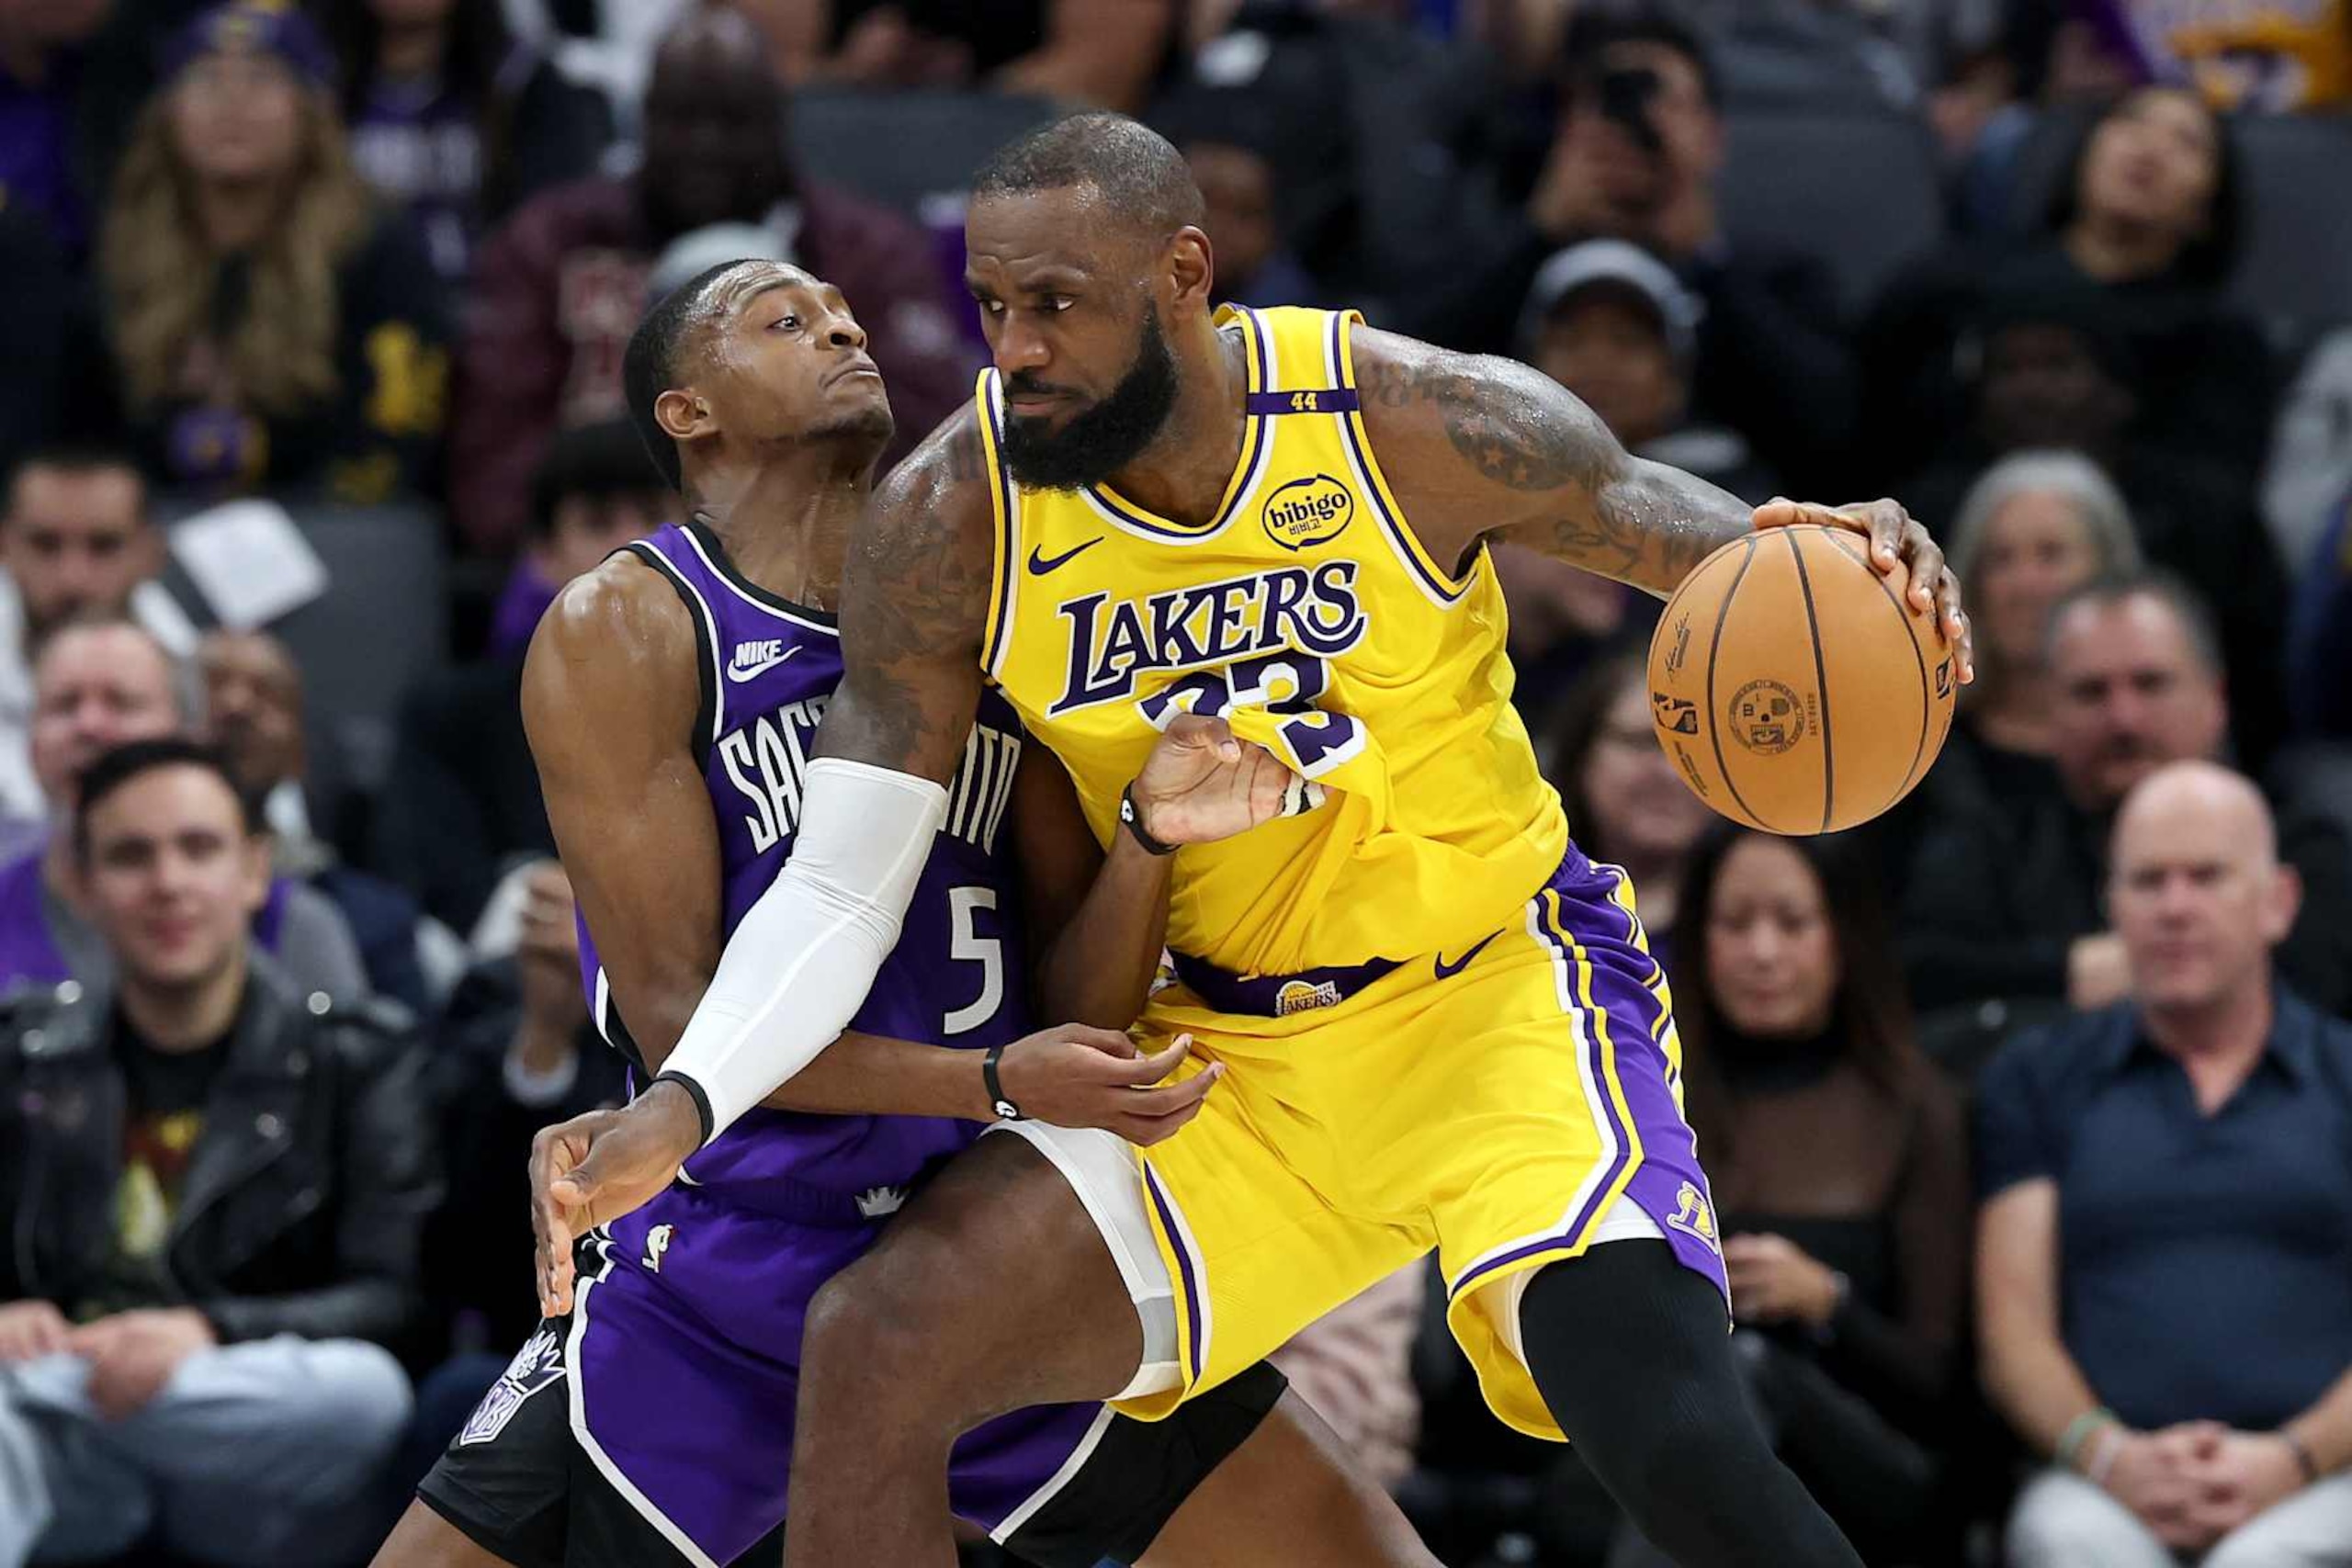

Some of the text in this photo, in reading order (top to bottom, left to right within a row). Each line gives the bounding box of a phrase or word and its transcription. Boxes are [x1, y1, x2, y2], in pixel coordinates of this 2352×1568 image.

[1290, 391, 1317, 412] 44
[1269, 493, 1346, 529] bibigo
[735, 639, 783, 667] NIKE
[1046, 560, 1368, 721] LAKERS
[944, 886, 1004, 1034] 5
[1280, 992, 1339, 1016] LAKERS
